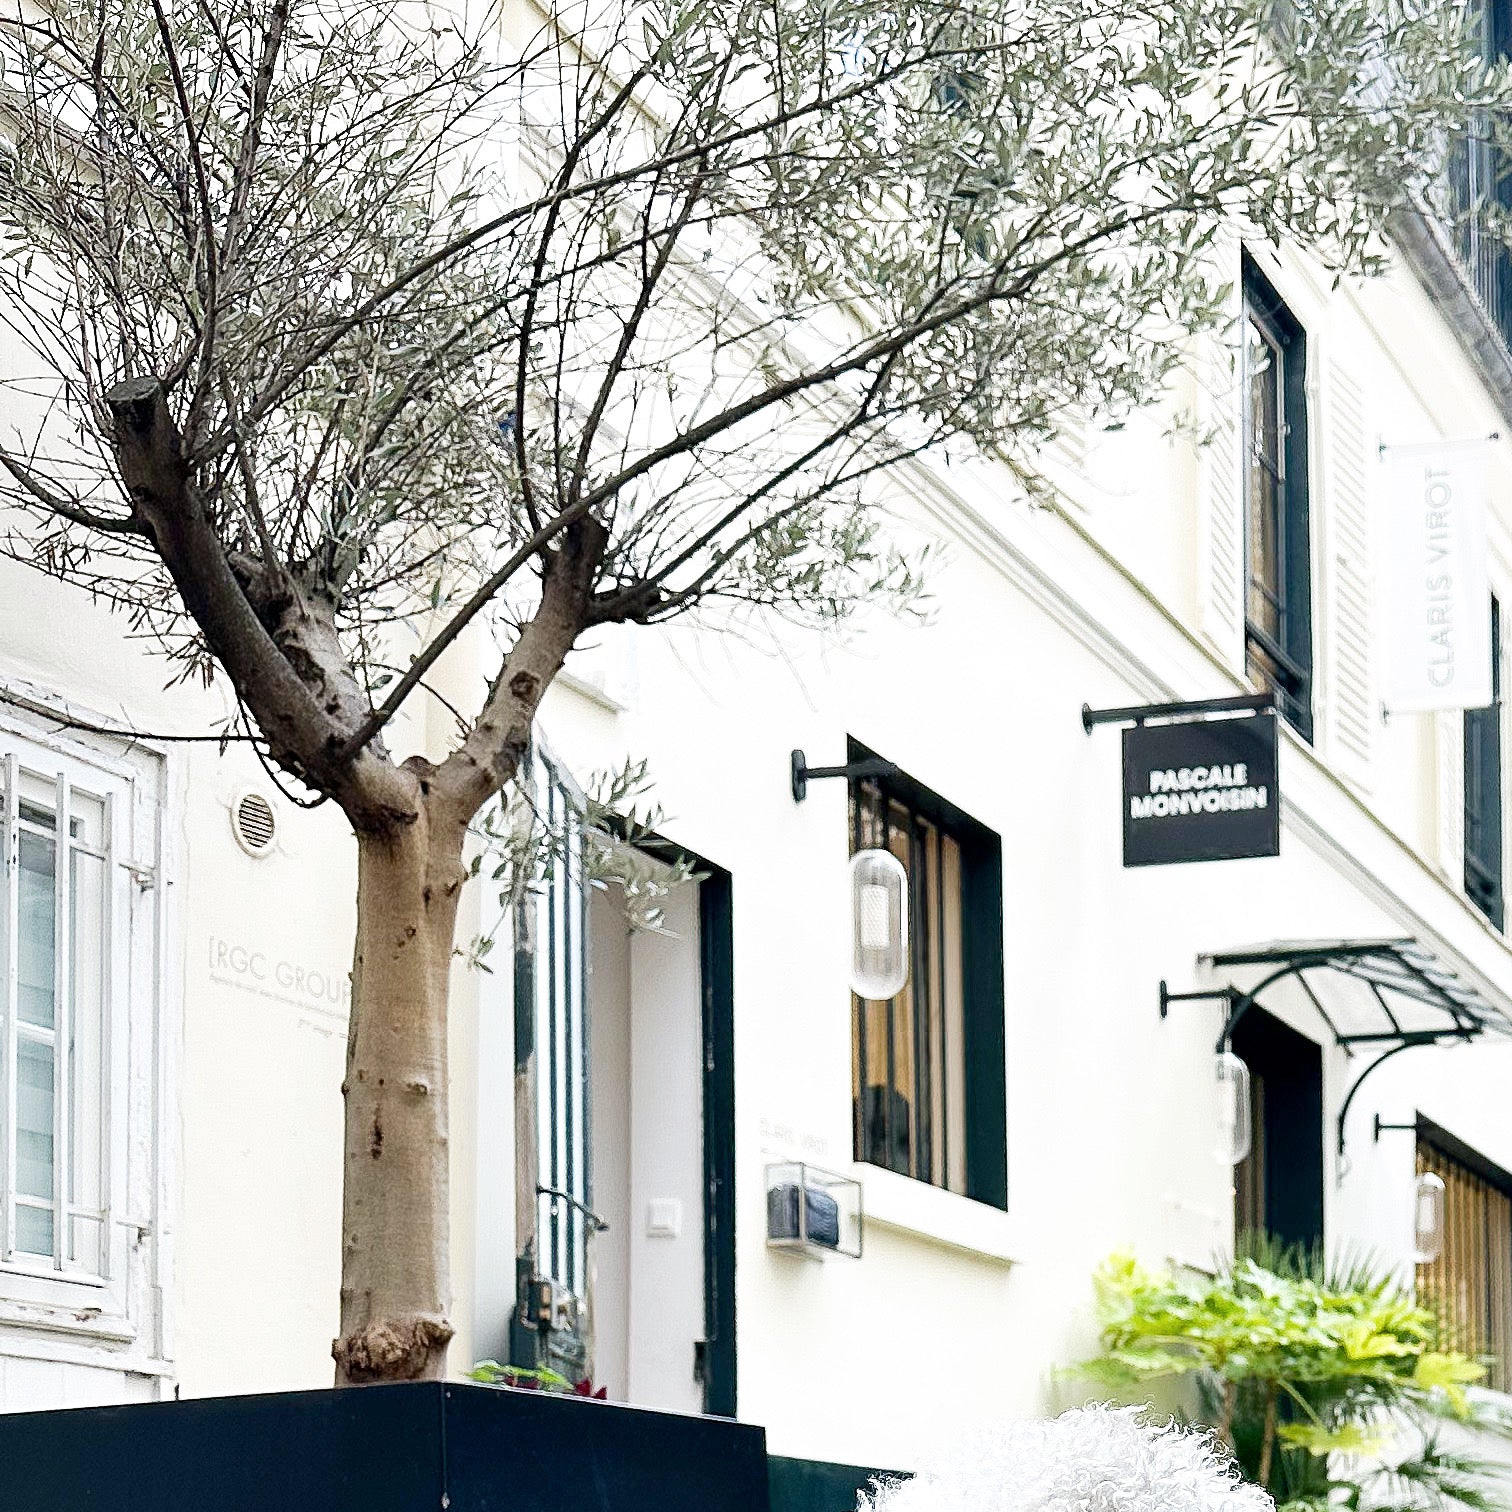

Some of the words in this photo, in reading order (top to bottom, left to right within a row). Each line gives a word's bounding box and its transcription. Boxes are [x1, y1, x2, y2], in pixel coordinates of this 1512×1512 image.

[1425, 465, 1453, 564] VIROT
[1426, 574, 1456, 688] CLARIS
[1130, 785, 1268, 819] MONVOISIN
[1150, 763, 1248, 794] PASCALE
